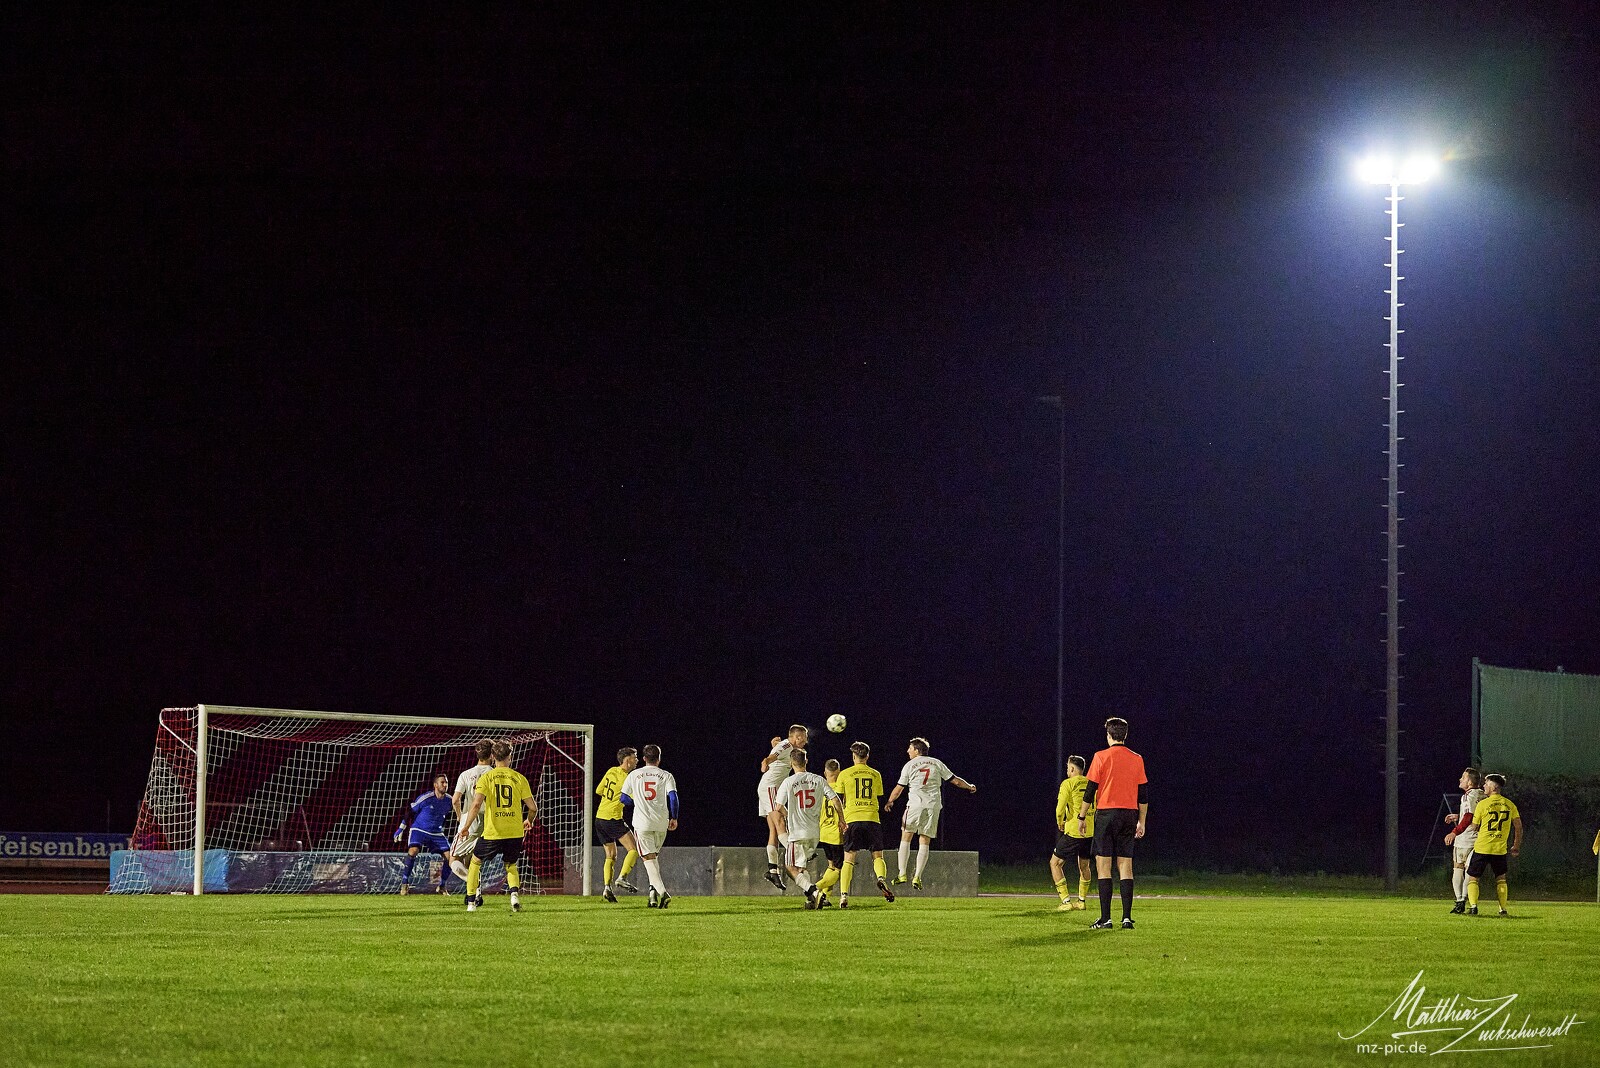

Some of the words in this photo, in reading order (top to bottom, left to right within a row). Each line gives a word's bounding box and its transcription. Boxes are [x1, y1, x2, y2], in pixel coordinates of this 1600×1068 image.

[919, 768, 930, 785] 7
[494, 783, 513, 808] 19
[644, 781, 657, 801] 5
[794, 788, 816, 810] 15
[854, 778, 873, 799] 18
[1487, 810, 1510, 832] 27
